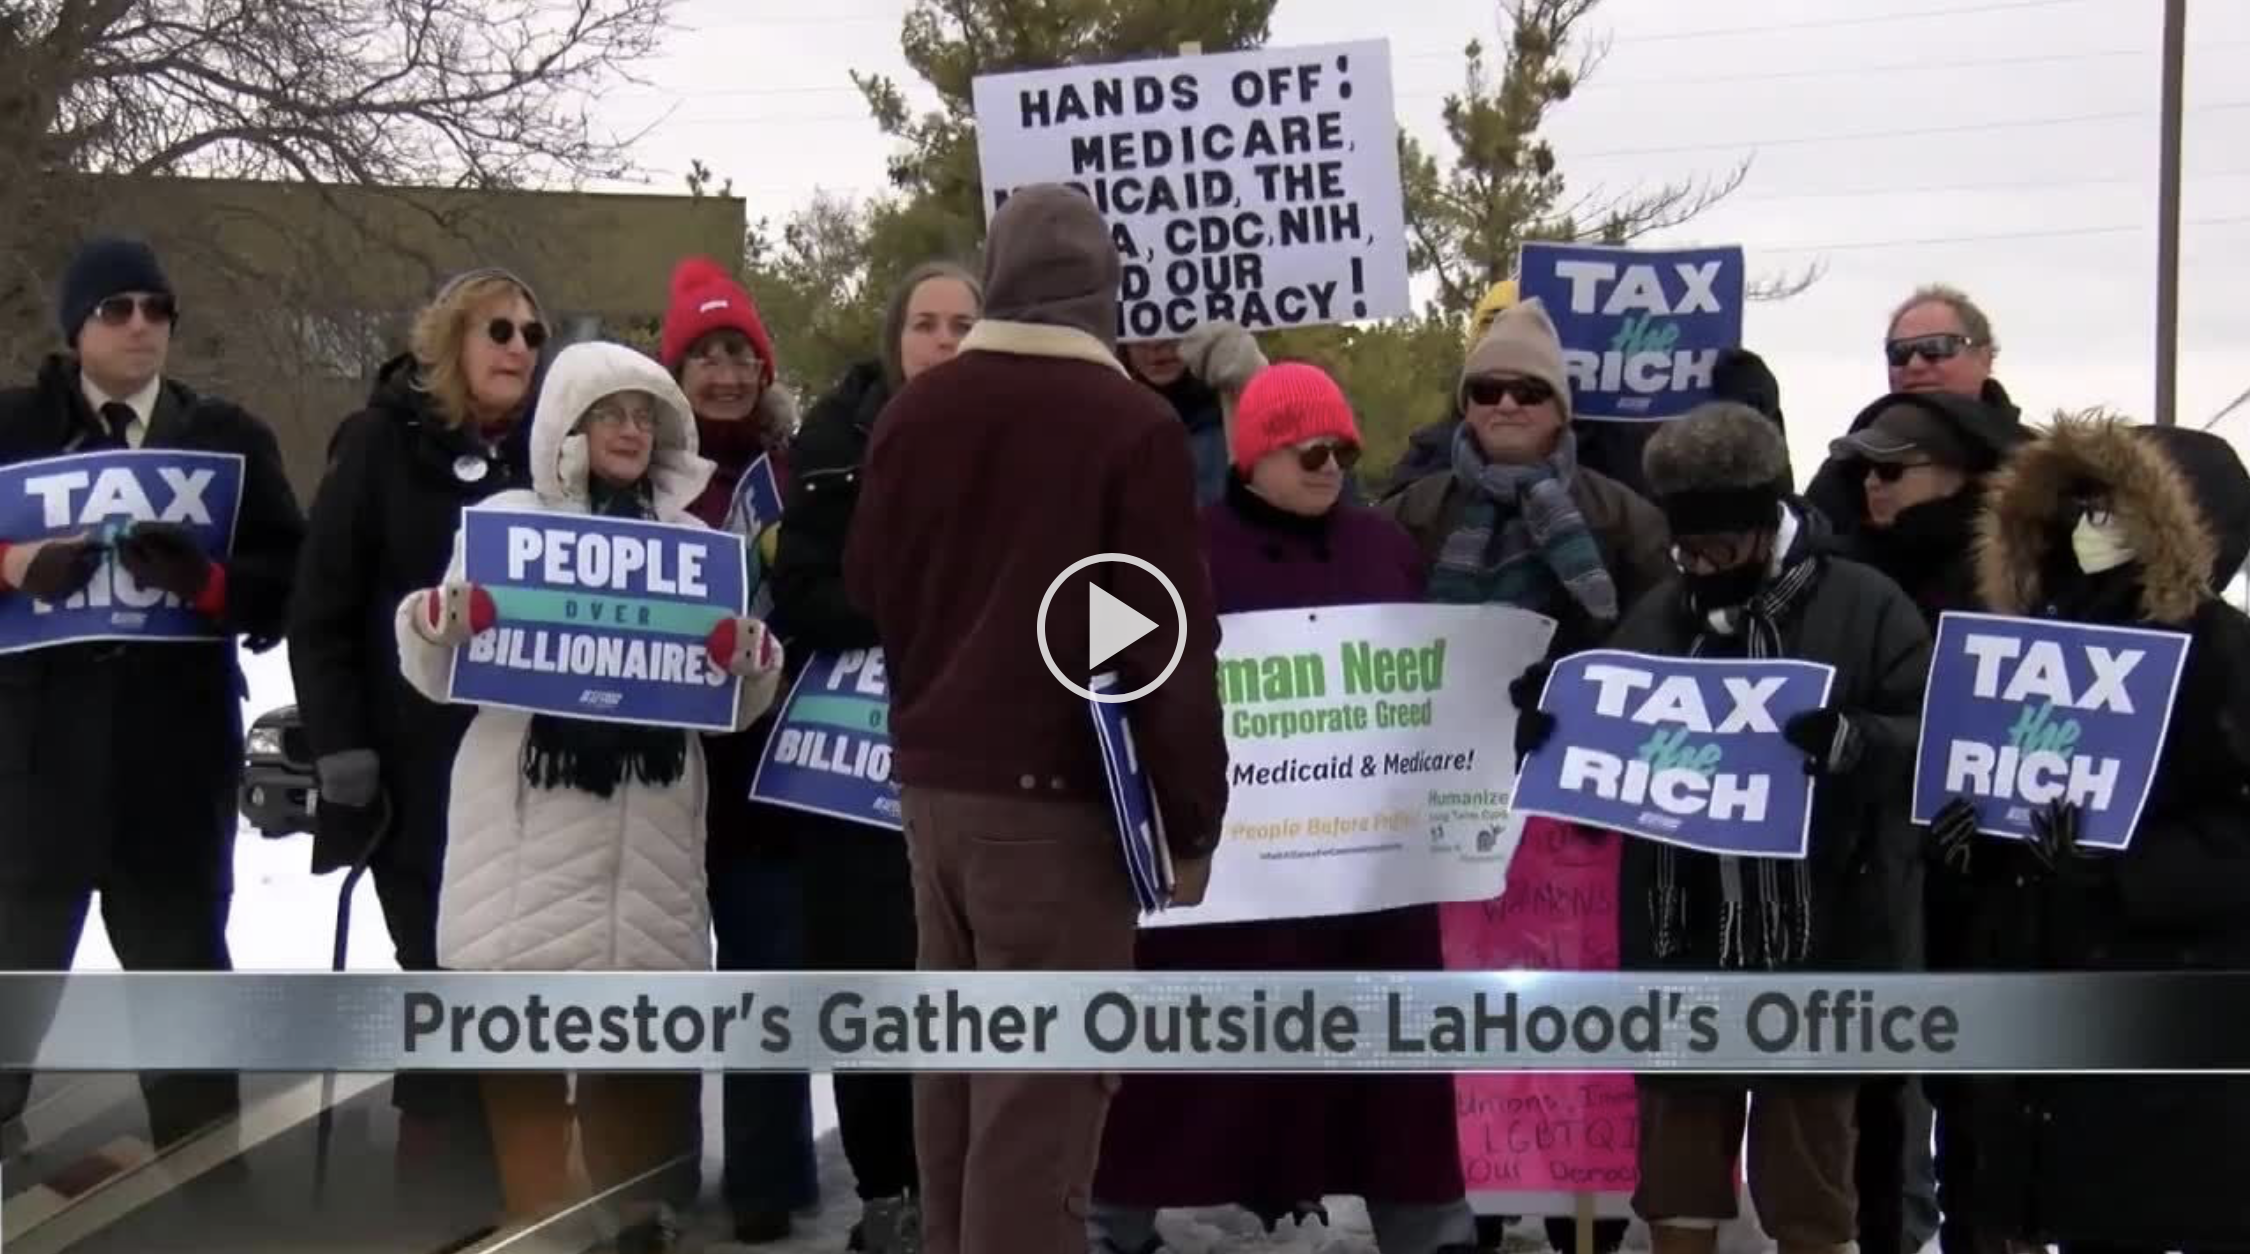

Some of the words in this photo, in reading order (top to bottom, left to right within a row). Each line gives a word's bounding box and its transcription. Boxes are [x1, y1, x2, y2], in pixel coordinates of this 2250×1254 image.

[1020, 74, 1199, 128] HANDS
[1071, 112, 1356, 175] MEDICARE,
[994, 170, 1241, 216] ICAID,
[1254, 161, 1346, 202] THE
[1166, 252, 1263, 294] OUR
[1554, 260, 1723, 316] TAX
[1562, 349, 1720, 393] RICH
[25, 467, 216, 528] TAX
[507, 526, 709, 598] PEOPLE
[565, 600, 652, 626] OVER
[1219, 651, 1326, 705] man
[1341, 638, 1446, 694] Need
[1964, 634, 2147, 714] TAX
[1232, 704, 1368, 739] Corporate
[1376, 699, 1433, 728] Greed
[1583, 665, 1790, 734] TAX
[1232, 756, 1354, 786] Medicaid
[1360, 757, 1377, 778] &
[1384, 750, 1476, 776] Medicare!
[1559, 746, 1771, 822] RICH
[1945, 739, 2121, 811] RICH
[1427, 789, 1509, 807] Humanize
[1231, 818, 1299, 842] People
[1307, 816, 1369, 838] Before
[1467, 1157, 1522, 1184] Our
